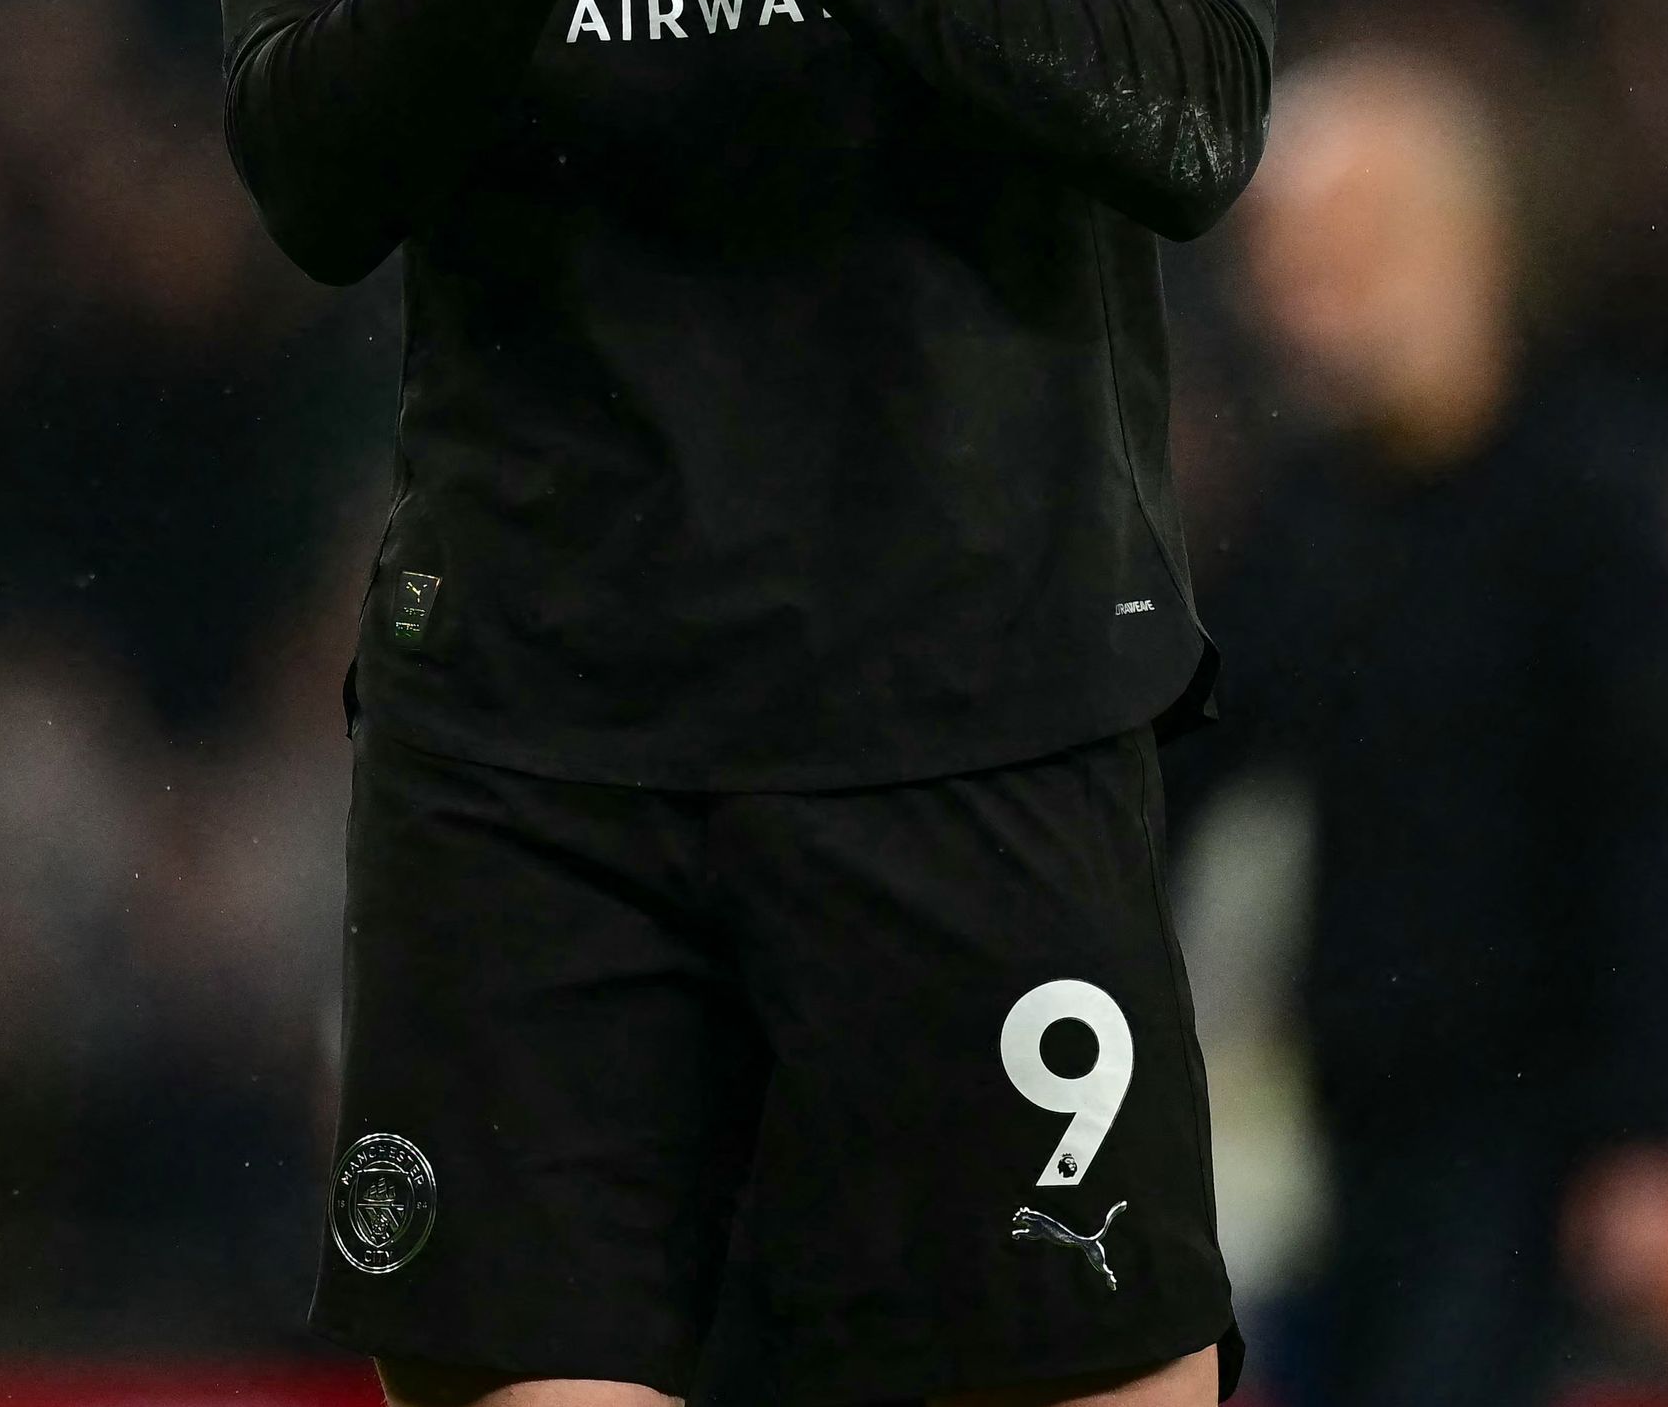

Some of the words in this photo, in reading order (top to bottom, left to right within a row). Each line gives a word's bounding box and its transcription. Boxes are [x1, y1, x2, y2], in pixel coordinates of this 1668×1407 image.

[1000, 979, 1134, 1186] 9
[341, 1144, 426, 1187] MANCHESTER
[363, 1249, 394, 1264] CITY
